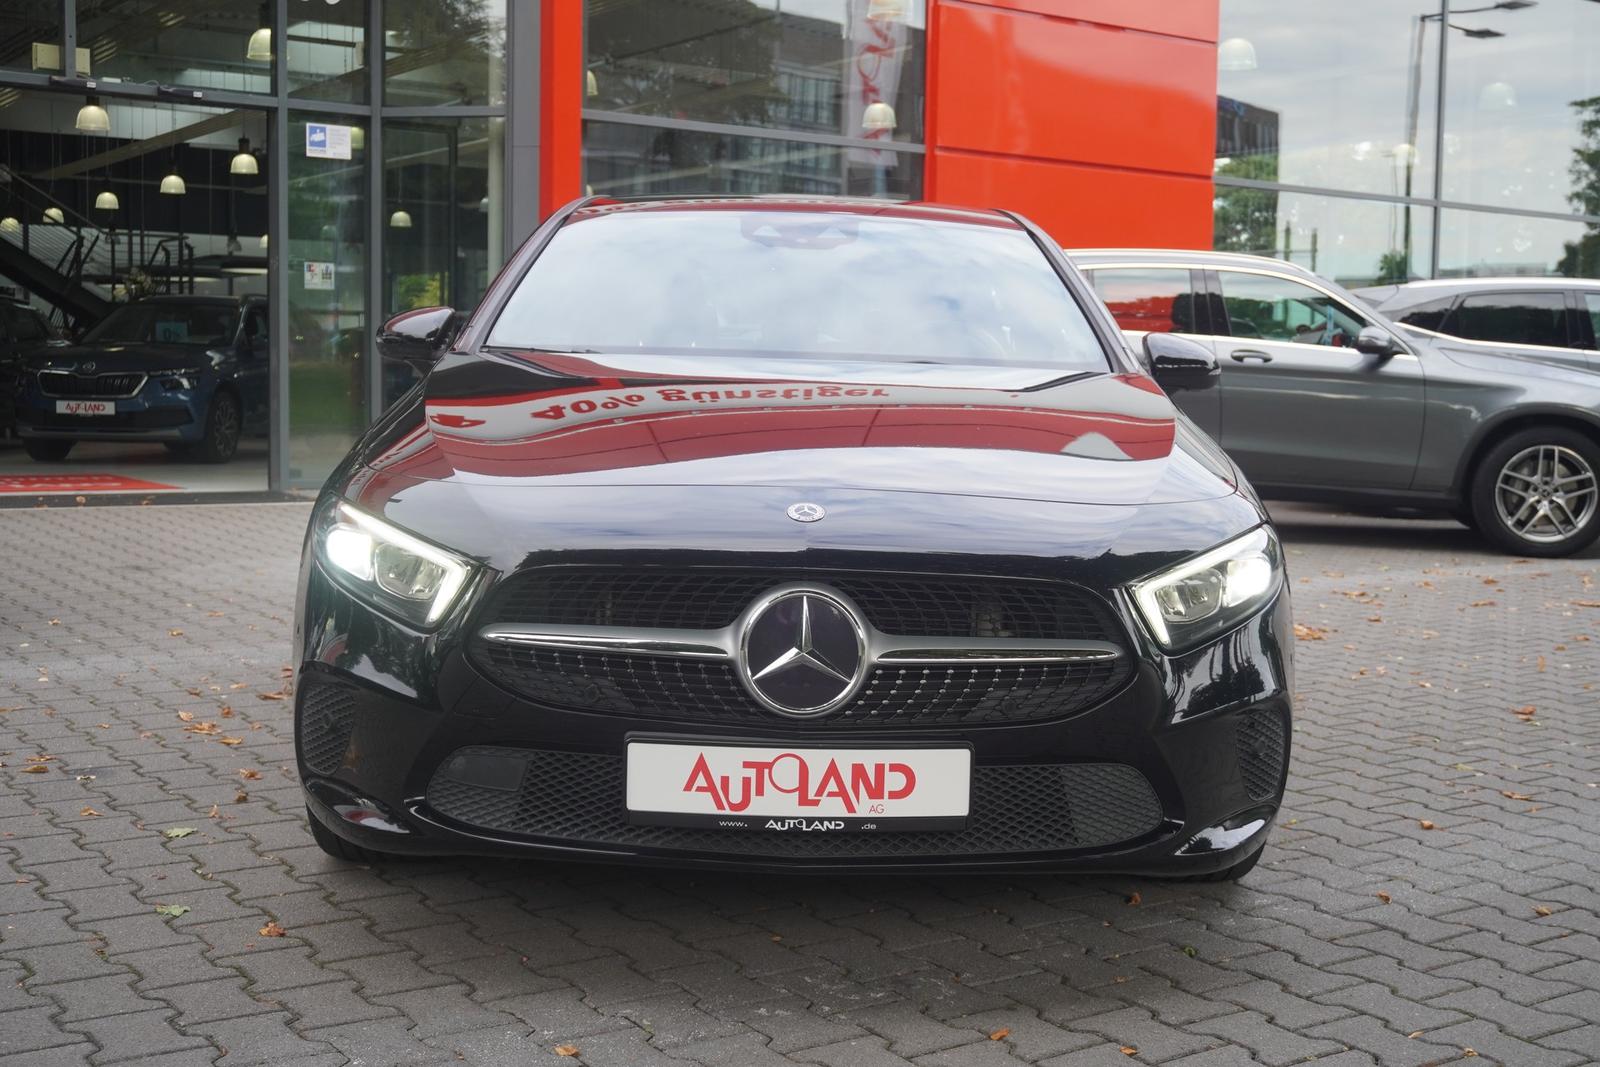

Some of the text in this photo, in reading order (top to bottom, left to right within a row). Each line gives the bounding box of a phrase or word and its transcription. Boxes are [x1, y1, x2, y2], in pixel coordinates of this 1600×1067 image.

[868, 804, 885, 814] AG
[719, 820, 748, 828] www.
[861, 822, 877, 830] .de
